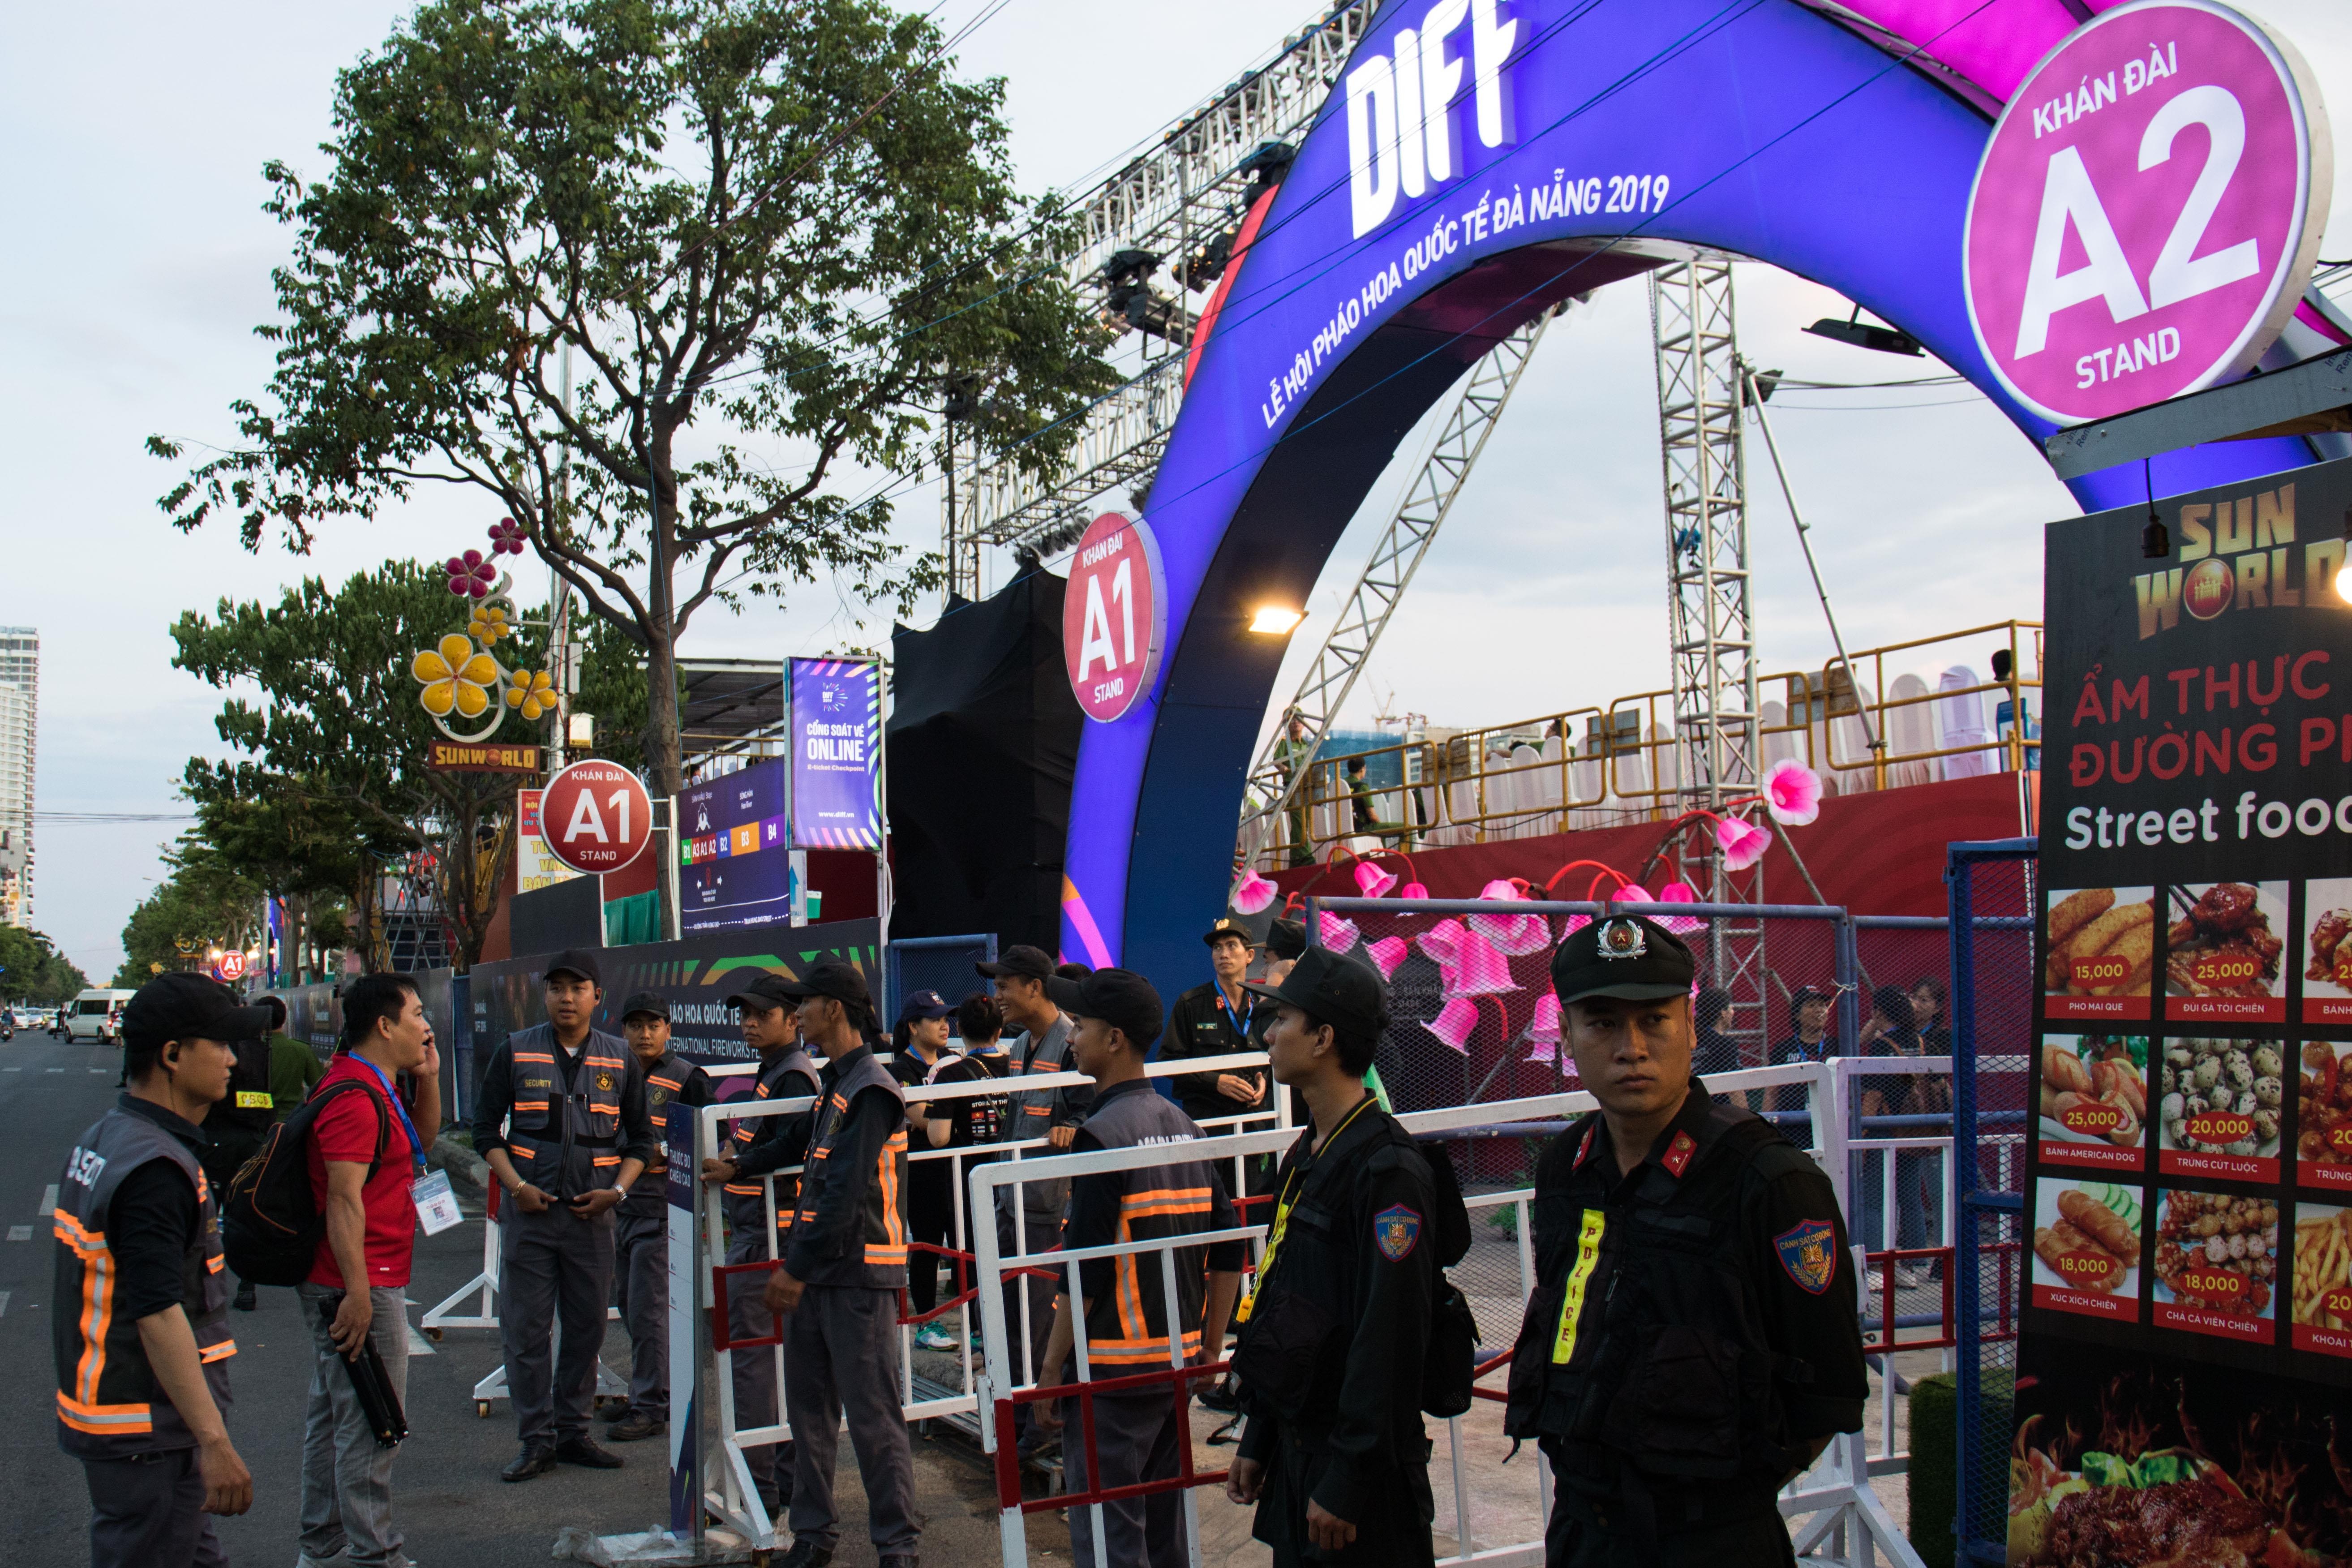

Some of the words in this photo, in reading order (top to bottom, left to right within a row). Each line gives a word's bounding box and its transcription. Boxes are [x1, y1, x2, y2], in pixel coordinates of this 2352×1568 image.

[2034, 74, 2117, 139] KHÁN
[2123, 41, 2178, 95] ĐÀI
[2014, 85, 2260, 360] A2
[1262, 379, 1286, 429] LỄ
[1283, 349, 1312, 393] HỘI
[1313, 297, 1360, 367] PHÁO
[1362, 273, 1402, 318] HOA
[1404, 215, 1458, 281] QUỐC
[1462, 190, 1490, 245] TẾ
[1493, 184, 1524, 234] ĐÀ
[1529, 168, 1602, 223] NẴNG
[1605, 175, 1670, 213] 2019
[2076, 326, 2181, 389] STAND
[2180, 483, 2295, 563] SUN
[1082, 539, 1107, 568] KHÁN
[1107, 530, 1123, 556] ĐÀI
[1078, 558, 1135, 683] A1
[1094, 678, 1124, 704] STAND
[2071, 663, 2149, 728] ẨM
[2168, 650, 2330, 716] THỰC
[807, 719, 829, 737] CỔNG
[831, 722, 852, 737] SOÁT
[854, 723, 864, 738] VÉ
[807, 738, 864, 761] ONLINE
[2068, 722, 2278, 788] ĐƯỜNG
[572, 769, 602, 781] KHÁN
[606, 770, 624, 782] ĐÀI
[563, 788, 630, 843] A1
[2065, 798, 2219, 850] Street
[684, 845, 691, 859] B1
[693, 843, 700, 858] A3
[700, 841, 708, 856] A1
[709, 839, 716, 854] A2
[720, 836, 728, 852] B2
[741, 830, 749, 847] B3
[768, 823, 777, 841] B4
[580, 851, 617, 861] STAND
[224, 957, 242, 971] A1
[2075, 964, 2123, 981] 15,000
[2197, 962, 2254, 981] 25,000
[685, 1004, 702, 1024] HOA
[704, 999, 727, 1026] QUỐC
[2105, 1003, 2123, 1011] QUE
[2235, 1003, 2265, 1013] CHIÊN
[712, 1039, 750, 1058] FIREWORKS
[524, 1078, 551, 1088] SECURITY
[2067, 1112, 2117, 1127] 25,000
[2191, 1120, 2249, 1136] 20,000
[2070, 1149, 2114, 1160] AMERICAN
[2116, 1152, 2135, 1162] DOG
[682, 1173, 691, 1187] CAO
[2060, 1258, 2107, 1274] 18,000
[1561, 1227, 1596, 1341] POLICE
[2185, 1274, 2239, 1292] 18,000
[2090, 1299, 2116, 1310] CHIÊN
[2329, 1294, 2351, 1310] 20
[2203, 1316, 2225, 1328] VIÊN
[2228, 1321, 2258, 1333] CHIÊN
[2312, 1334, 2346, 1348] KHOAI
